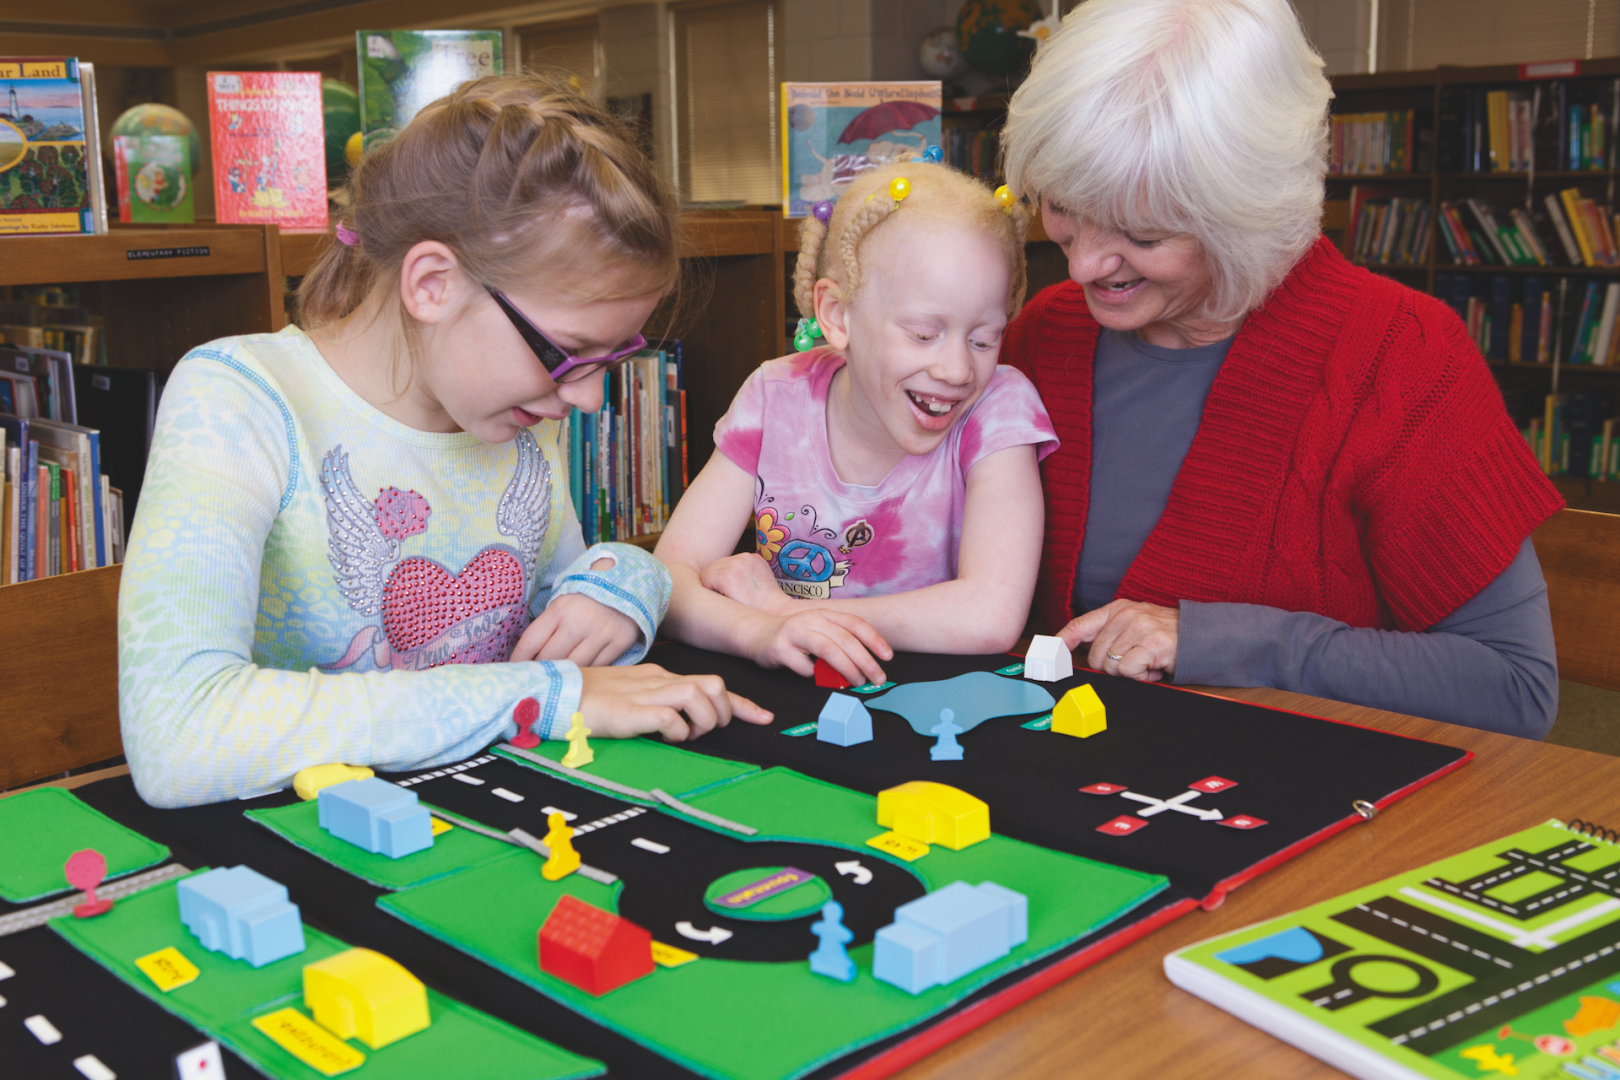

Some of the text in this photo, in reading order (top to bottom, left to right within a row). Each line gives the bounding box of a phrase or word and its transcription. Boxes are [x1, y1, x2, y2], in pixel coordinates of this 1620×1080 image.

[18, 62, 61, 78] Land
[790, 88, 822, 98] Behold
[216, 98, 260, 112] THINGS
[261, 98, 277, 112] TO
[127, 248, 208, 259] ELEMENTARY FICTION
[20, 482, 28, 512] UNDER
[83, 484, 91, 503] WHAT
[19, 513, 27, 530] THE
[84, 505, 92, 524] GAME
[19, 531, 27, 556] QUILT
[19, 558, 26, 569] OF
